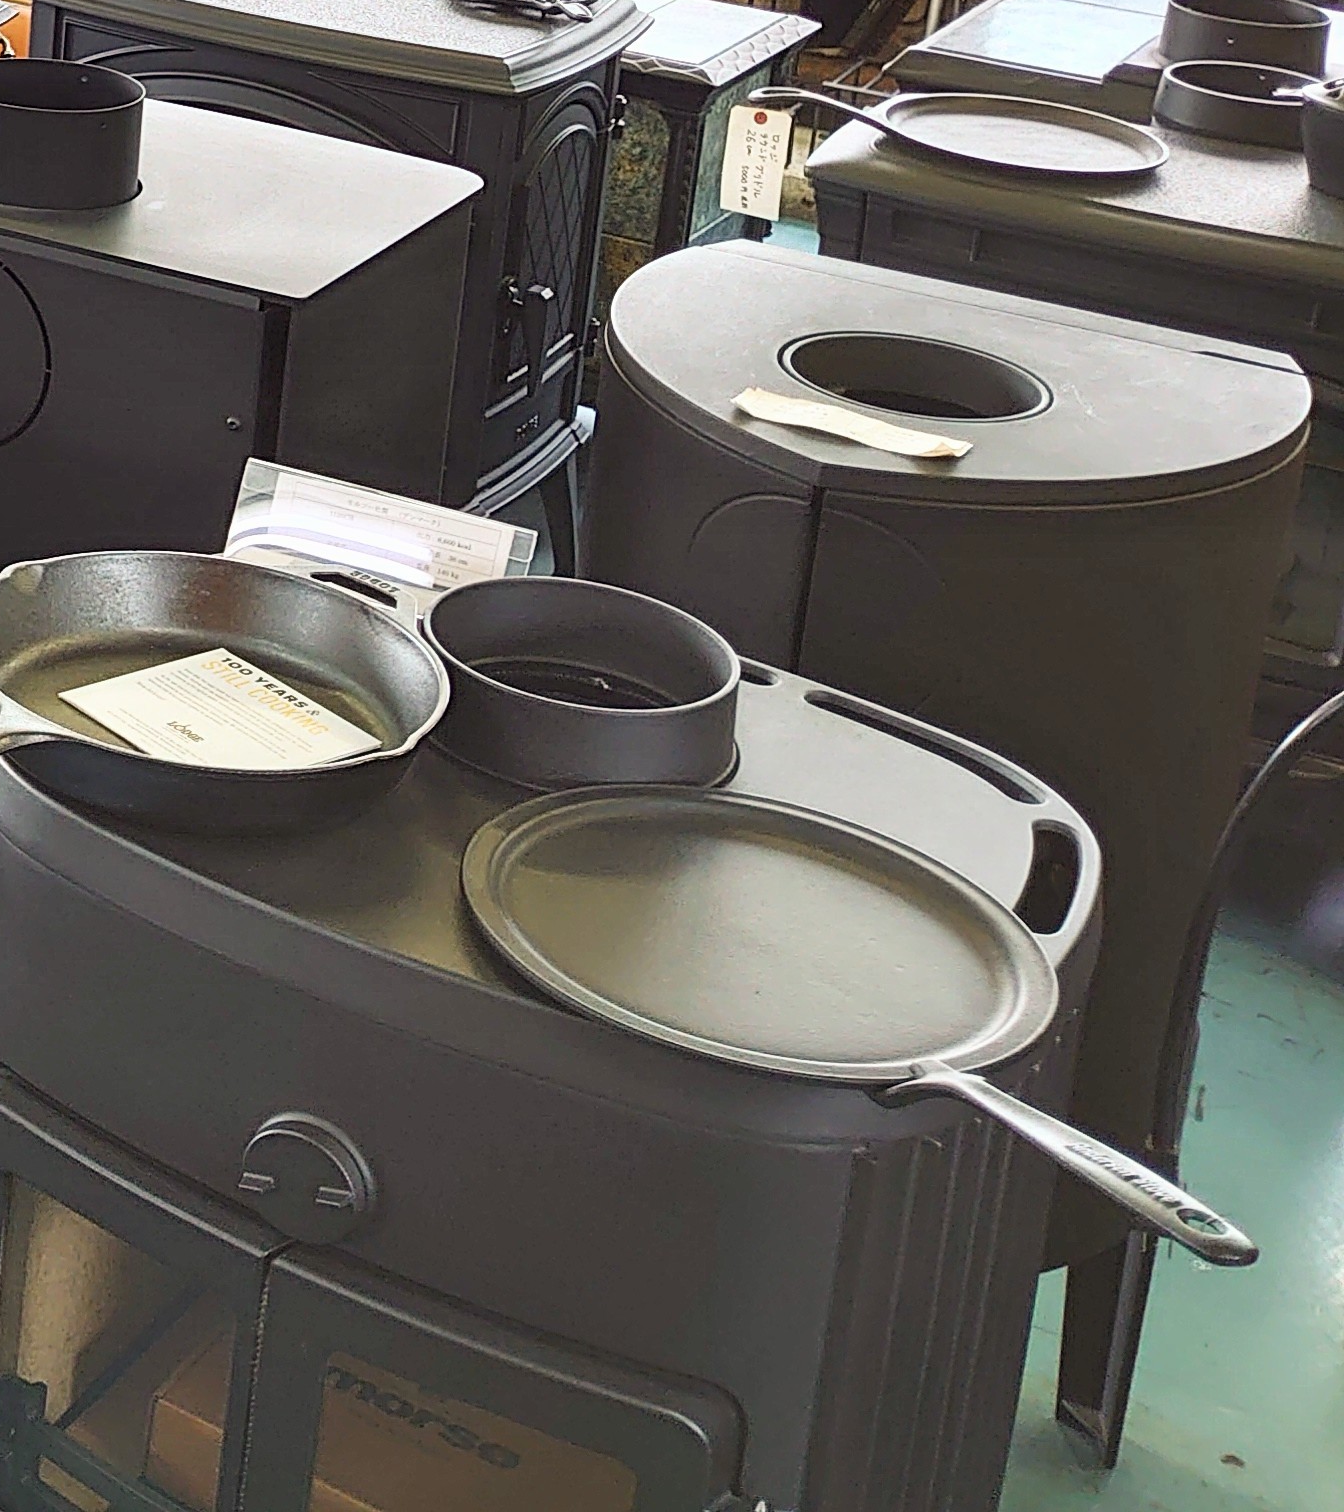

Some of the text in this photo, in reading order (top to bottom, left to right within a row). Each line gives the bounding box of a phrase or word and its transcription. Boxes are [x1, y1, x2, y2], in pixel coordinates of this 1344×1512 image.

[201, 659, 251, 690] STILL
[247, 687, 329, 736] COOKING
[221, 657, 253, 676] 100
[255, 676, 309, 709] YEARS
[167, 720, 205, 743] LODGE
